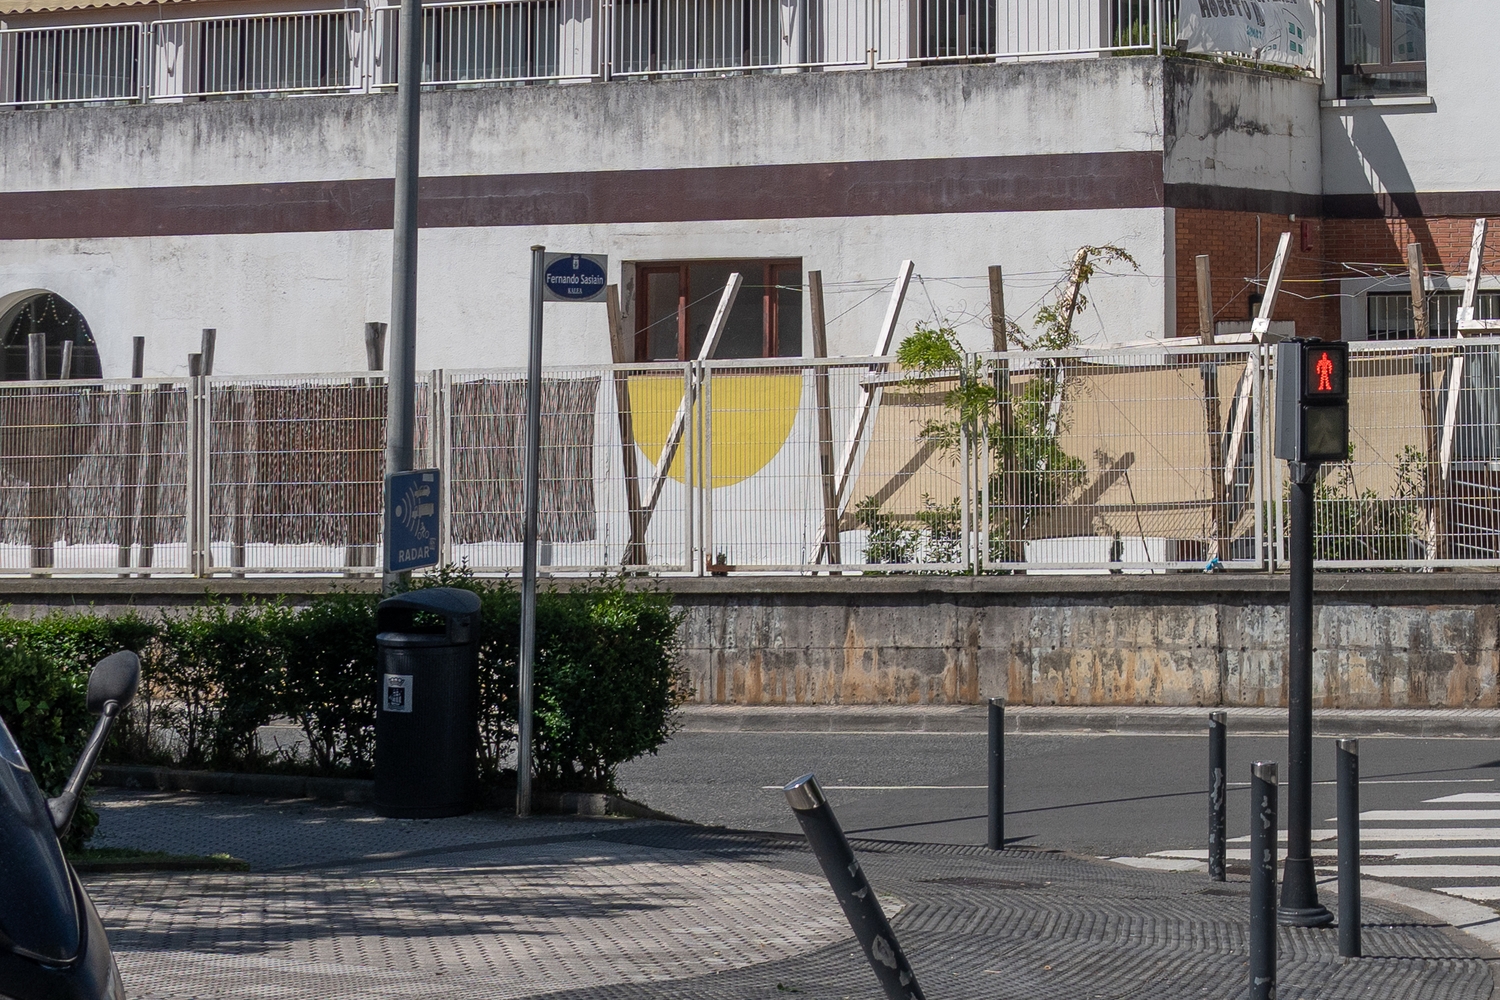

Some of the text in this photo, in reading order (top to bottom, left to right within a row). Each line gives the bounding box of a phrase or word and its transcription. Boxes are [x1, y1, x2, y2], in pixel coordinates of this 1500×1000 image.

[546, 273, 603, 285] Fernando Sasiain
[398, 546, 430, 563] RADAR
